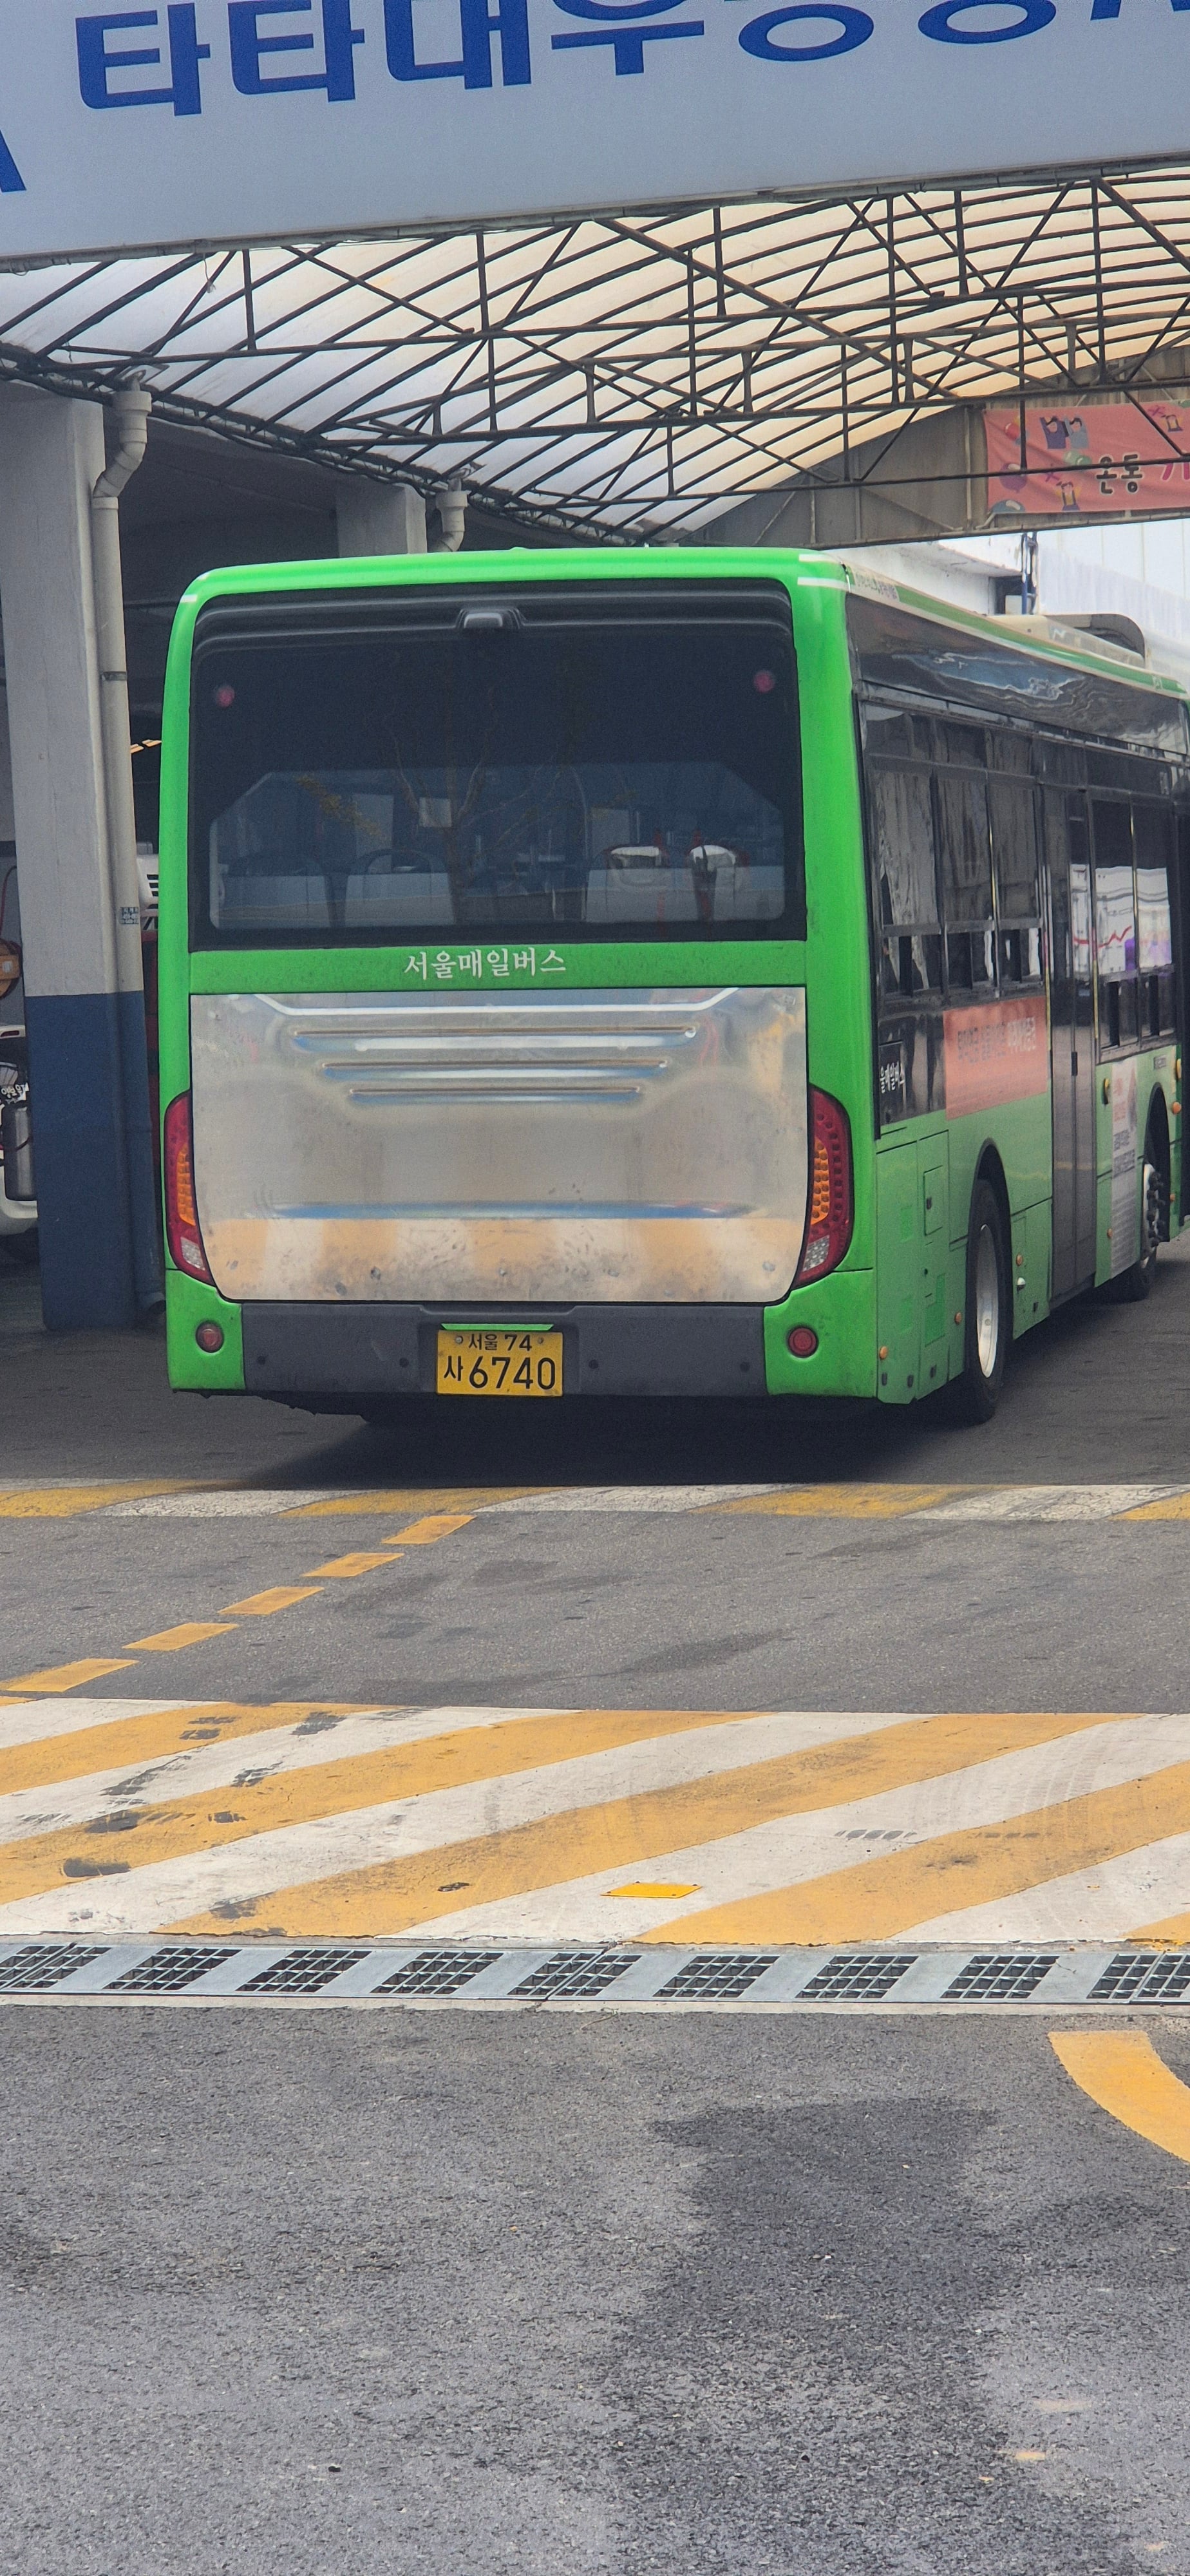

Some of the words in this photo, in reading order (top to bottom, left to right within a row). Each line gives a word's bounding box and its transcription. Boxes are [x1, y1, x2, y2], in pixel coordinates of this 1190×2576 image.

[75, 0, 1190, 116] 타타대우
[404, 947, 567, 981] 서울매일버스
[879, 1061, 905, 1094] 울매일버스
[468, 1333, 498, 1351] 서울
[504, 1334, 533, 1352] 74
